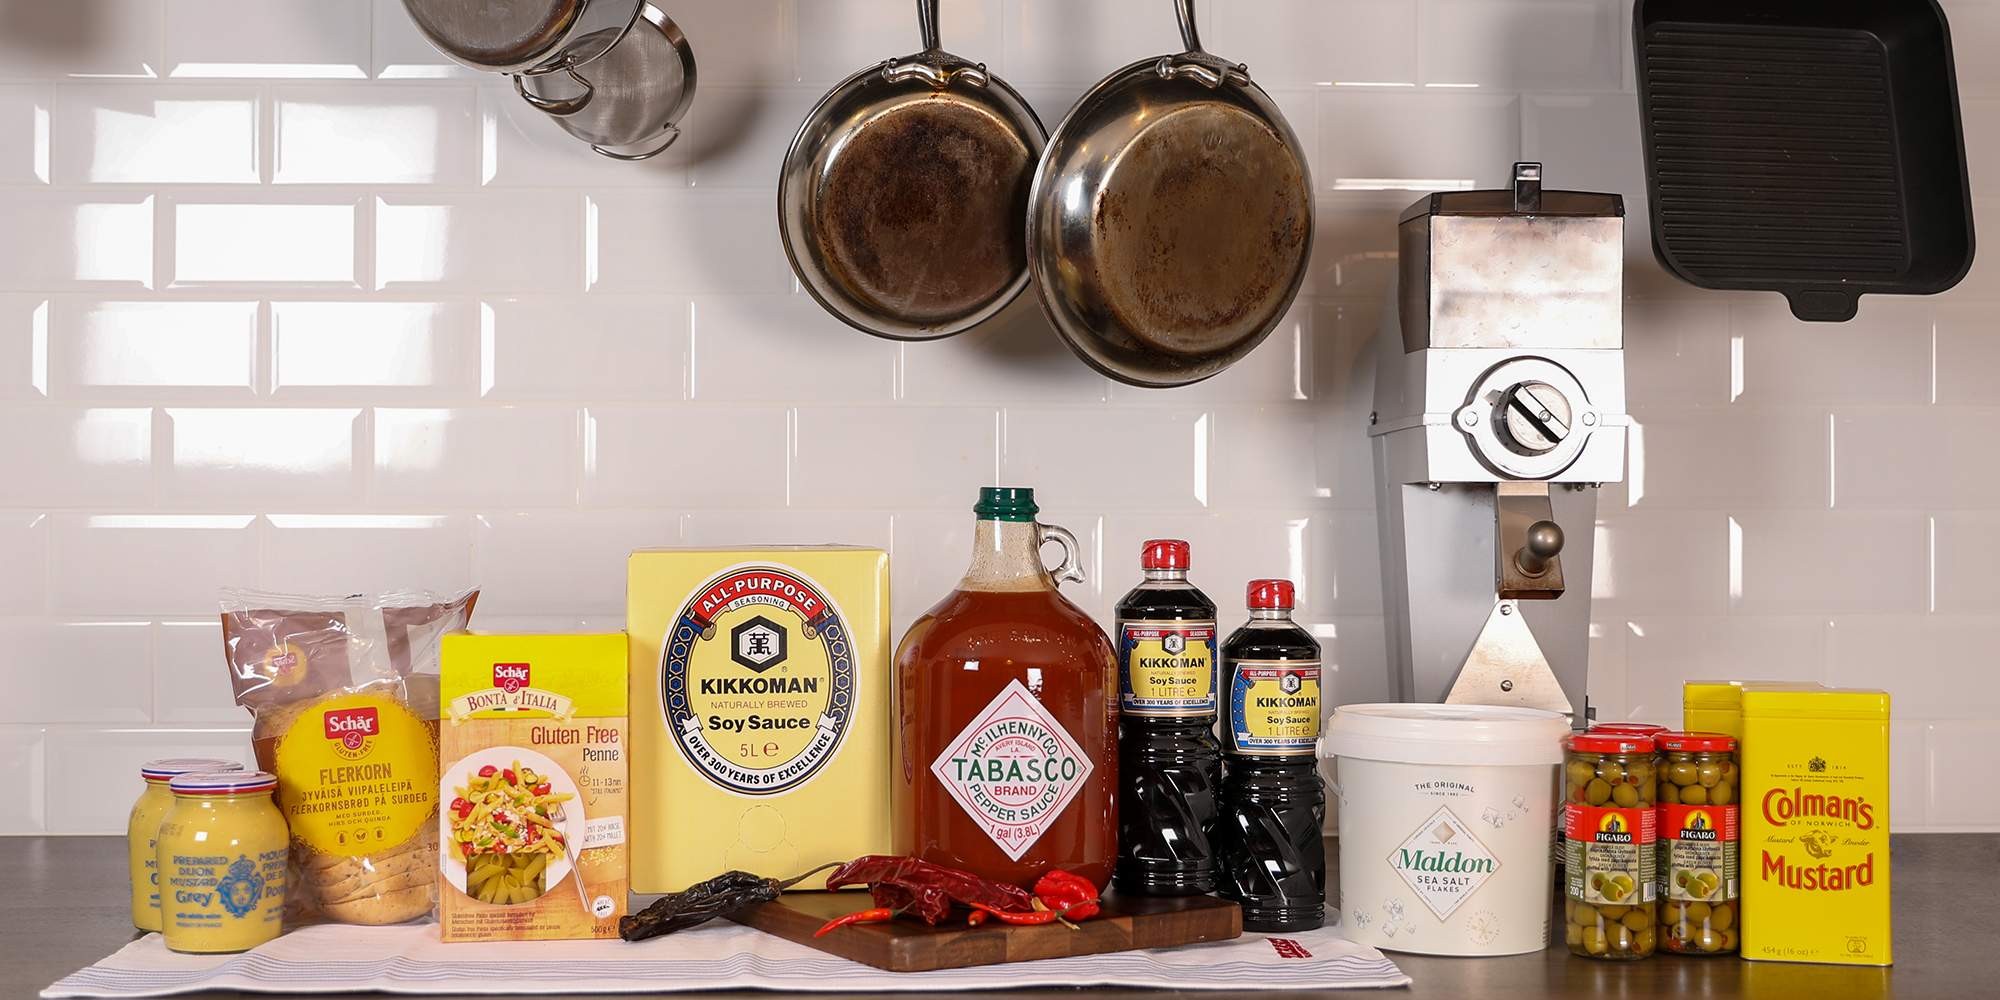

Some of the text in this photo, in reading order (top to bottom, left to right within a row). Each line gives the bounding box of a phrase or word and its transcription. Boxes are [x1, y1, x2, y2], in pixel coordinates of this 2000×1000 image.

[702, 577, 817, 613] ALL-PURPOSE
[735, 596, 784, 608] SEASONING
[1140, 658, 1204, 668] KIKKOMAN
[496, 666, 528, 680] Schär
[701, 678, 818, 694] KIKKOMAN
[1150, 677, 1167, 686] Soy
[1151, 687, 1184, 696] 1 LITRE
[467, 690, 507, 711] BONTÀ
[711, 700, 808, 709] NATURALLY BREWED
[1257, 697, 1316, 707] KIKKOMAN
[329, 716, 374, 732] Schär
[709, 715, 810, 733] Soy Sauce
[1267, 716, 1284, 725] Soy
[531, 726, 618, 744] Gluten Free
[1269, 726, 1300, 735] 1 LITRE
[334, 739, 372, 758] GLUTEN-FREE
[995, 740, 1036, 751] AVERY ISLAND
[583, 748, 619, 761] Penne
[689, 733, 831, 784] OVER 300 YEARS OF EXCELLENCE
[320, 763, 392, 785] FLERKORN
[952, 757, 1076, 782] TABASCO
[302, 779, 412, 801] JYVÄISÄ VIIPALELEIPÄ
[994, 786, 1037, 796] BRAND
[1415, 782, 1474, 793] THE ORIGINAL
[291, 792, 427, 815] FLERKORNSBRØD PÅ SURDEG
[970, 783, 1059, 821] PEPPER SAUCE
[1762, 787, 1874, 830] Colman's
[364, 815, 391, 823] QUINOA
[1806, 820, 1851, 828] NORWICH
[989, 823, 1040, 841] 1 gal (3.8L)
[1764, 835, 1870, 846] Mustard Powder
[173, 855, 228, 865] PREPARED
[1397, 848, 1493, 873] Maldon
[179, 867, 213, 876] DIJON
[1762, 849, 1873, 891] Mustard
[170, 877, 218, 886] MUSTARD
[266, 872, 277, 881] DE
[1417, 875, 1470, 885] SEA SALT
[1570, 886, 1579, 896] 200
[176, 890, 212, 907] Grey
[1783, 947, 1794, 956] (16
[1797, 948, 1808, 956] oz)
